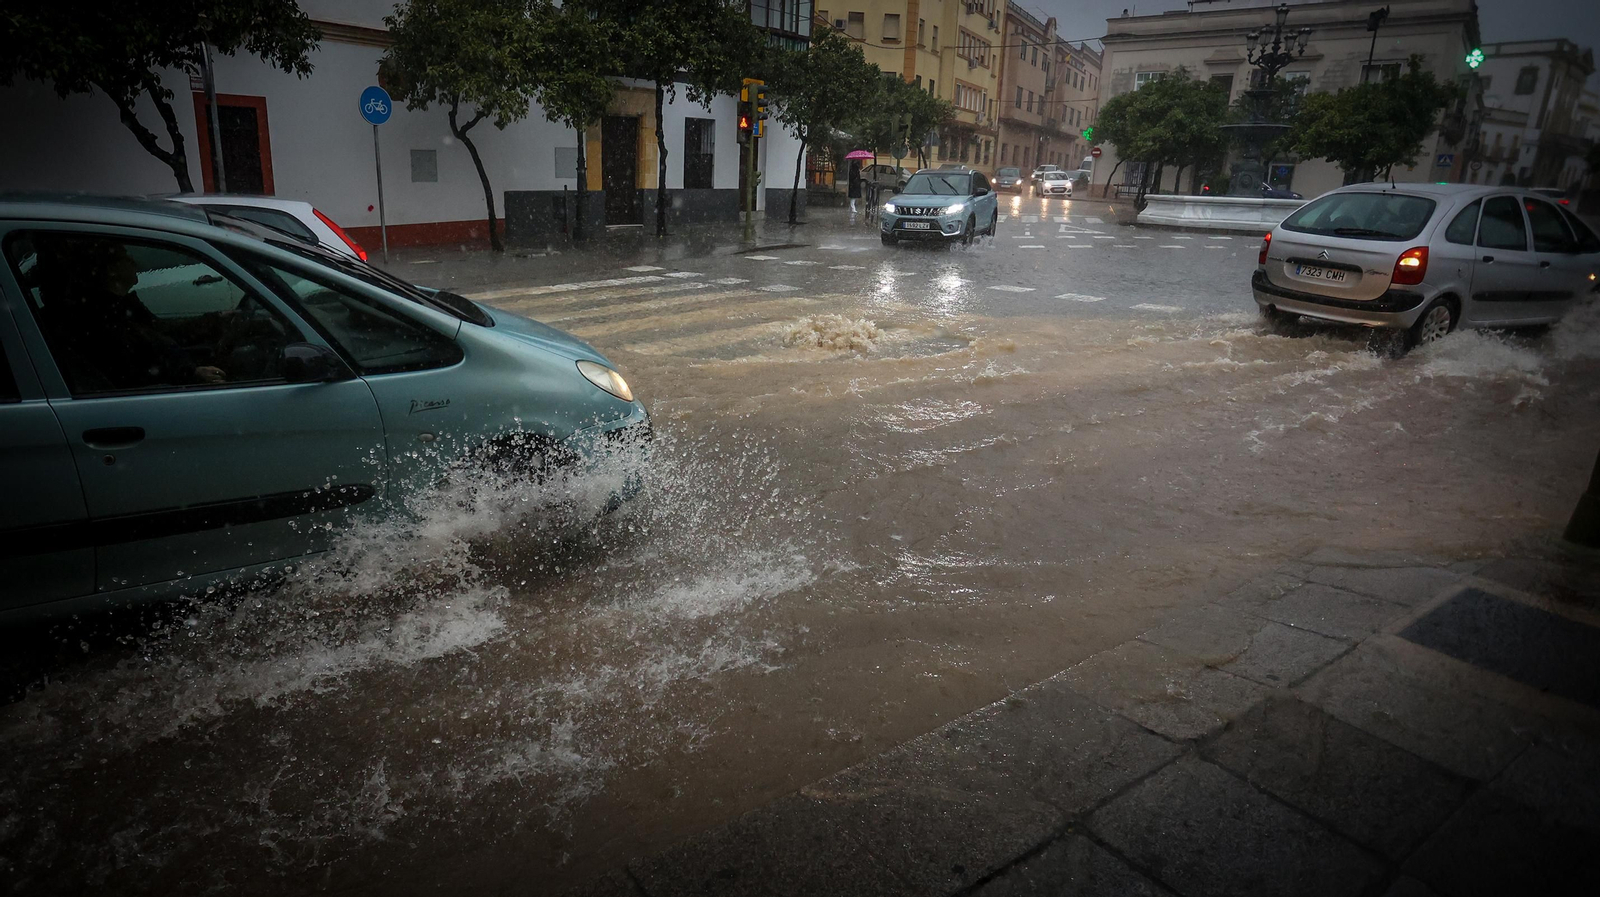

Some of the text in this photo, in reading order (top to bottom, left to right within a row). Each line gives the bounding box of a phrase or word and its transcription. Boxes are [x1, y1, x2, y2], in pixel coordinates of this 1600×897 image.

[1300, 265, 1346, 281] 7323 CMH
[408, 399, 451, 415] Picasso
